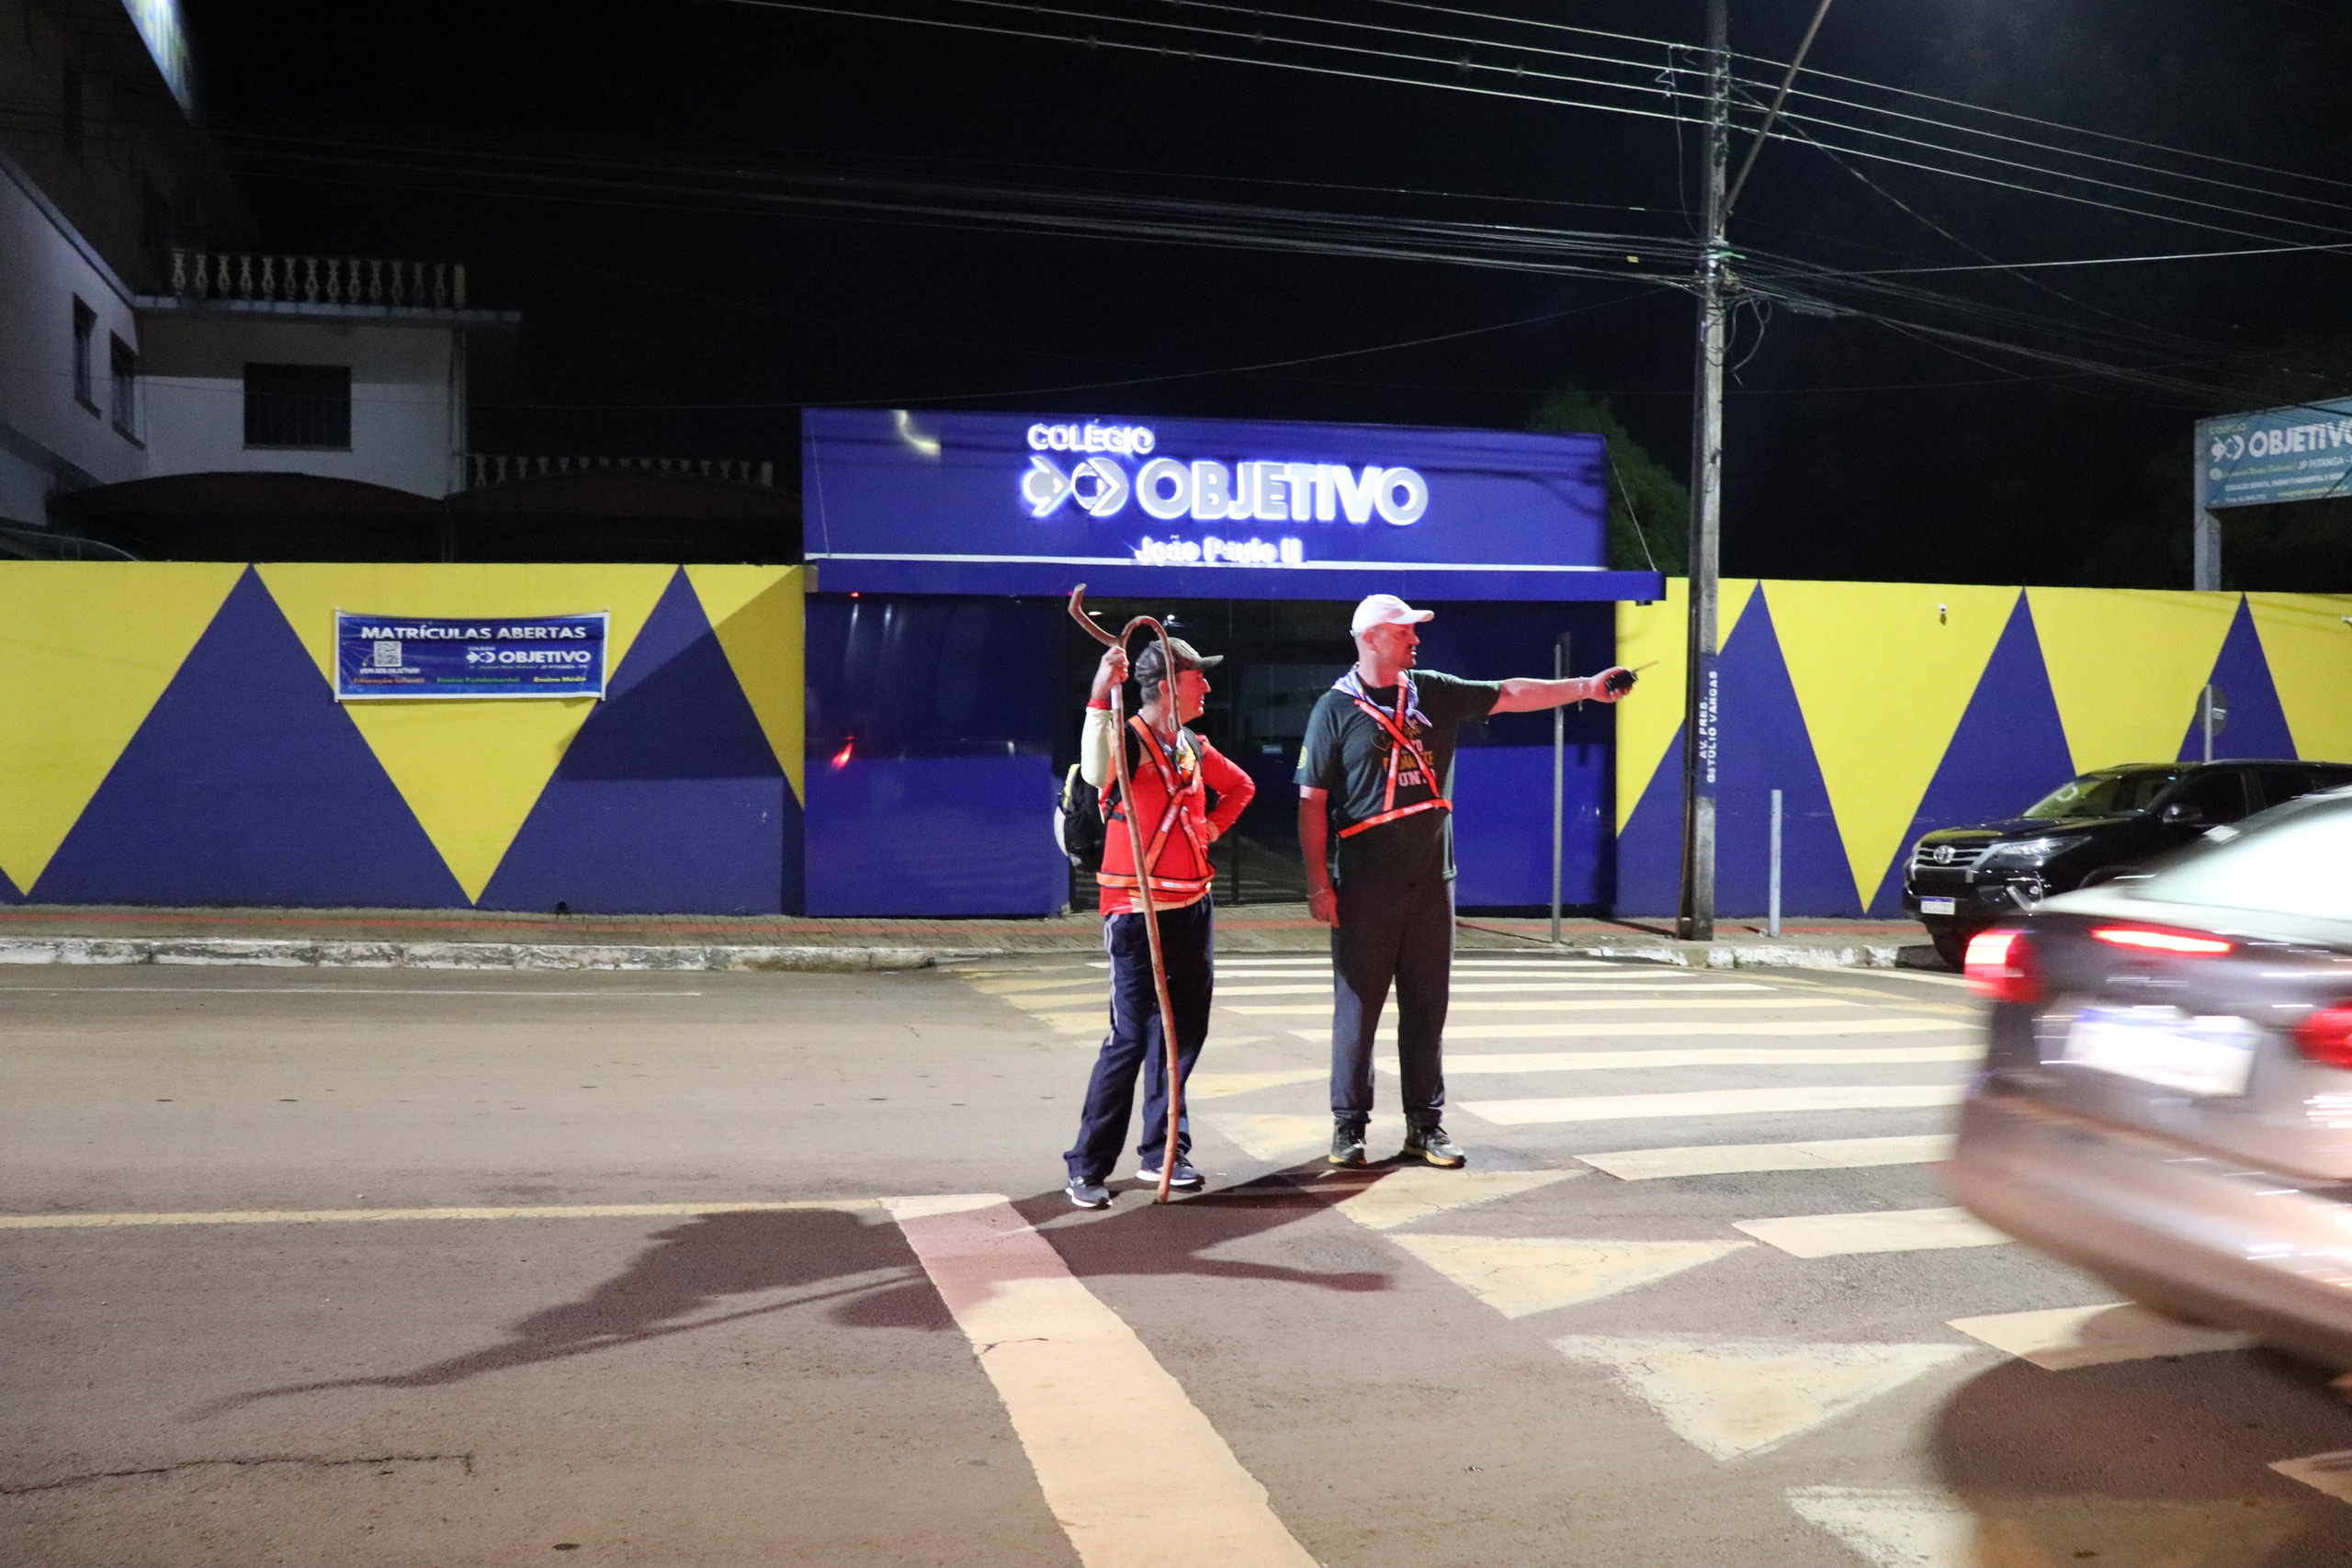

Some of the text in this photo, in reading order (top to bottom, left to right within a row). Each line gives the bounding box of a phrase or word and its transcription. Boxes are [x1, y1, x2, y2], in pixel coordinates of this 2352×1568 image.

[1027, 418, 1155, 455] COLÉGIO
[1136, 457, 1429, 526] OBJETIVO
[1135, 533, 1303, 563] João Paulo II
[361, 625, 586, 639] MATRÍCULAS ABERTAS
[498, 650, 592, 663] OBJETIVO
[1708, 671, 1718, 722] VARGAS
[1699, 739, 1708, 759] AV.
